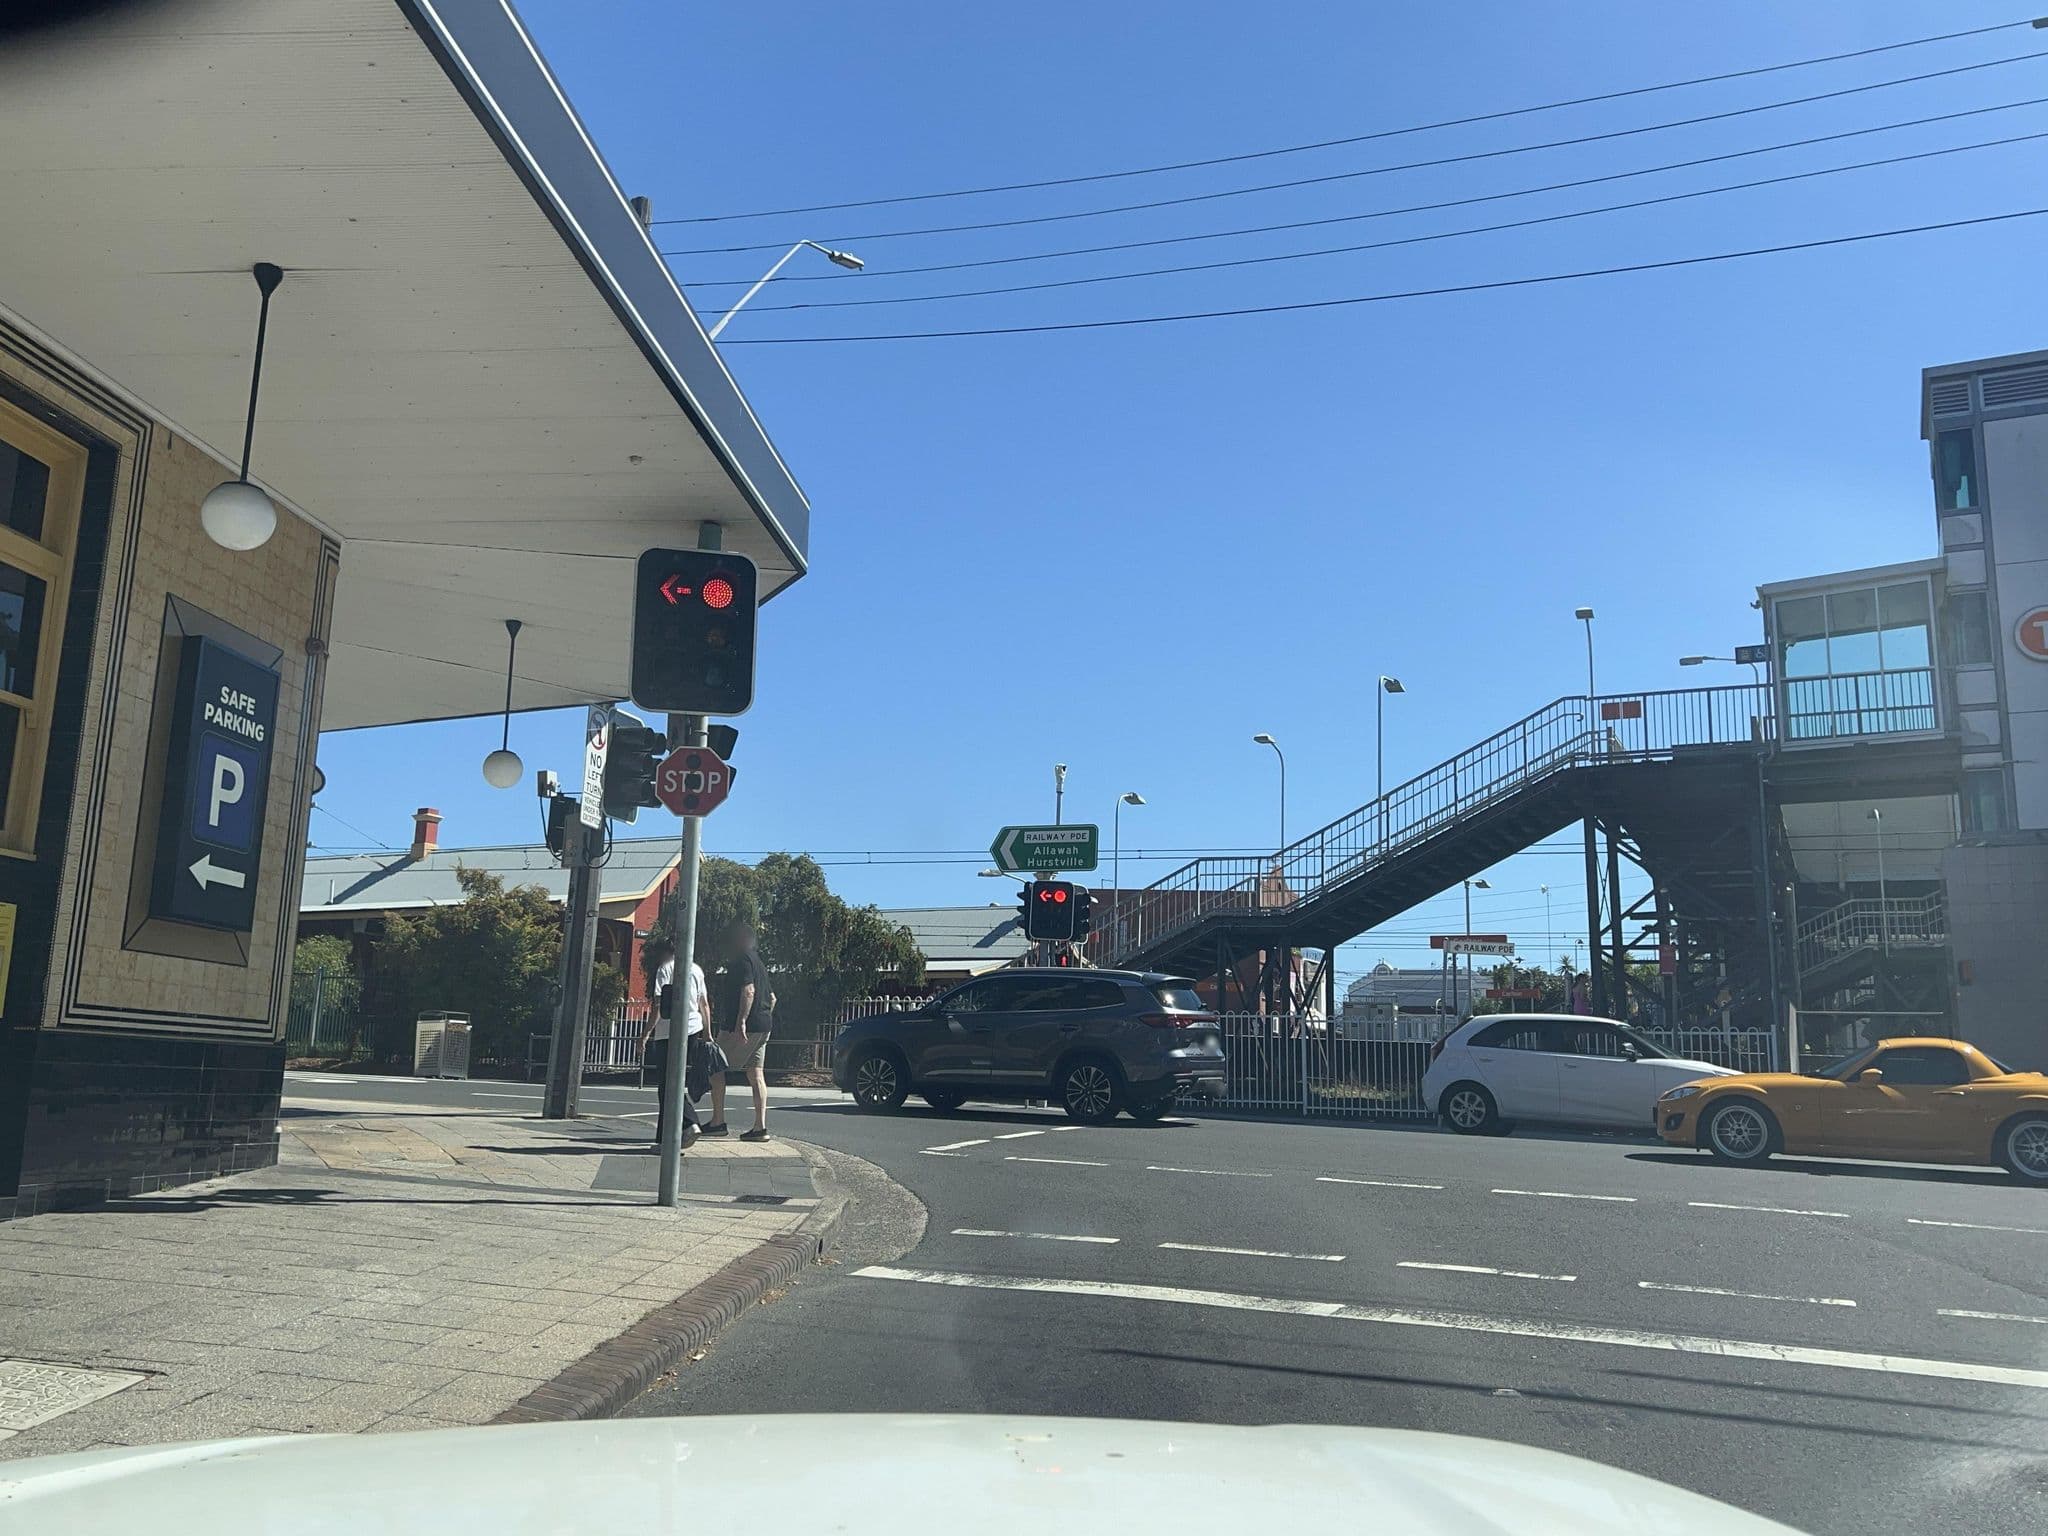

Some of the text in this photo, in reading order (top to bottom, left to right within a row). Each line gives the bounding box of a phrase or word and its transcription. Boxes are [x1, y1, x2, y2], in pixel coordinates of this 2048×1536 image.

[220, 686, 256, 715] SAFE
[204, 702, 264, 742] PARKING
[590, 752, 602, 769] NO
[588, 770, 601, 781] LEF
[664, 770, 722, 793] STOP
[208, 754, 245, 827] P
[586, 781, 603, 795] TURN
[1026, 832, 1087, 841] RAILWAY PDE
[1033, 846, 1079, 855] Allawah
[1027, 857, 1084, 867] Hurstville
[1463, 944, 1514, 953] RAILWAY PDE
